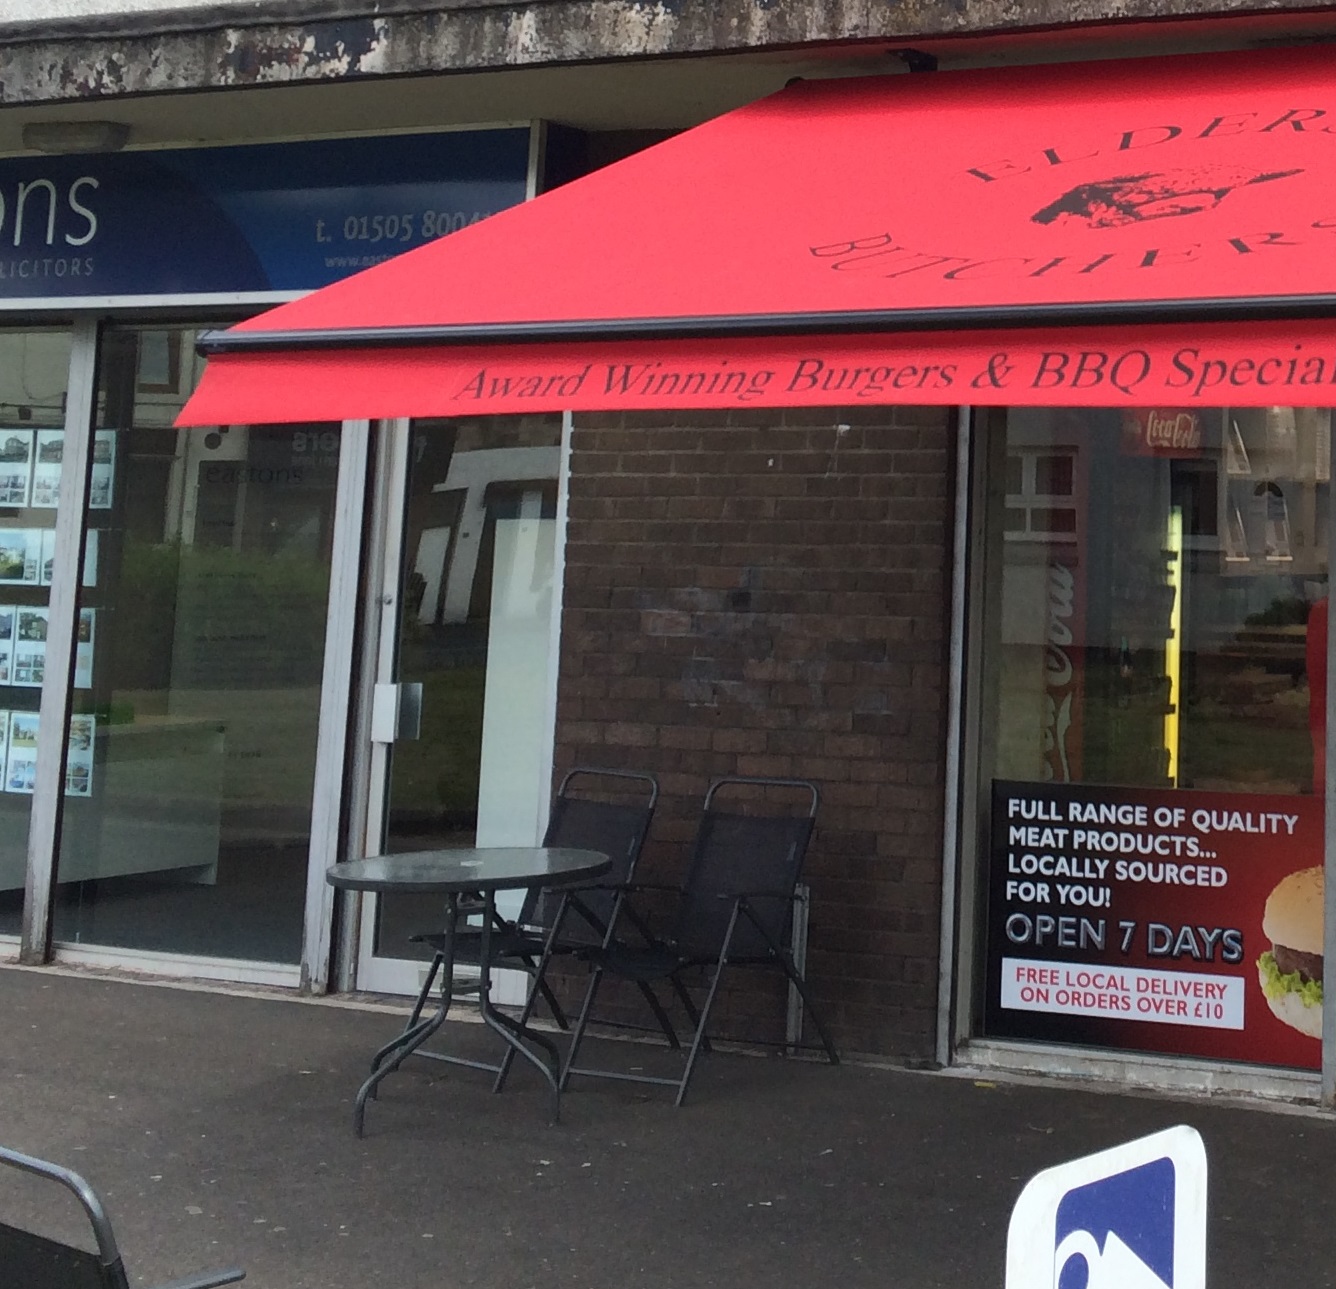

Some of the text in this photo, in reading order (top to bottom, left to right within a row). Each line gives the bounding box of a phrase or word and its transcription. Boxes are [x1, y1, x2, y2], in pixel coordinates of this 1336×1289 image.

[0, 176, 99, 247] ns
[343, 213, 415, 243] 01505
[454, 362, 592, 401] Award
[600, 359, 775, 400] Winning
[785, 358, 958, 397] Burgers
[969, 352, 1014, 389] &
[1030, 349, 1151, 396] BBQ
[1008, 798, 1299, 835] FULL RANGE OF QUALITY
[1009, 825, 1217, 859] MEAT PRODUCTS...
[1008, 853, 1228, 888] LOCALLY SOURCED
[1006, 881, 1112, 908] FOR YOU!
[1005, 913, 1244, 964] OPEN 7 DAYS
[1015, 967, 1228, 1001] FREE LOCAL DELIVERY
[1020, 986, 1223, 1021] ON ORDERS OVER £10
